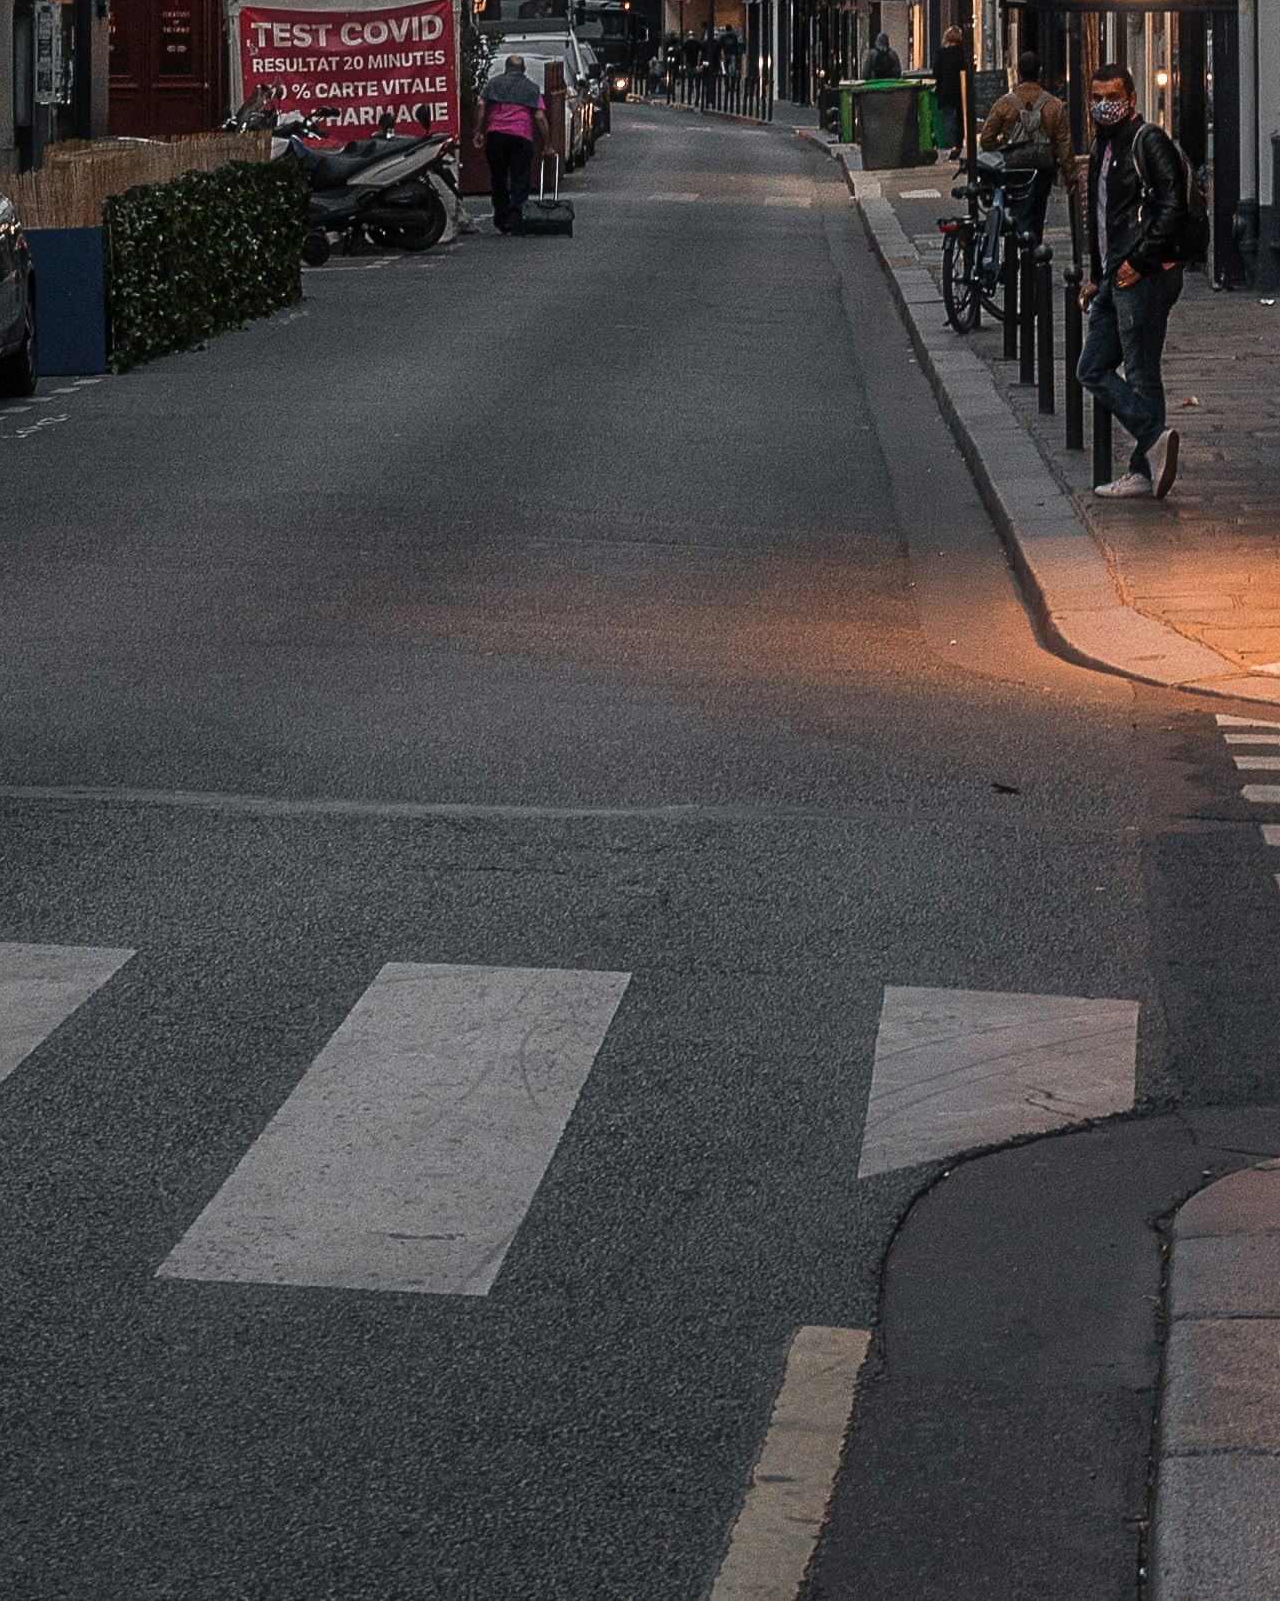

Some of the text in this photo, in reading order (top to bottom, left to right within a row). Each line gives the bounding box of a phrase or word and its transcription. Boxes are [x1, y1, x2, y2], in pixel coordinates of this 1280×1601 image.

[250, 14, 444, 48] TEST COVID
[252, 50, 445, 73] RESULTAT 20 MINUTES
[315, 80, 378, 98] CARTE
[382, 76, 447, 95] VITALE
